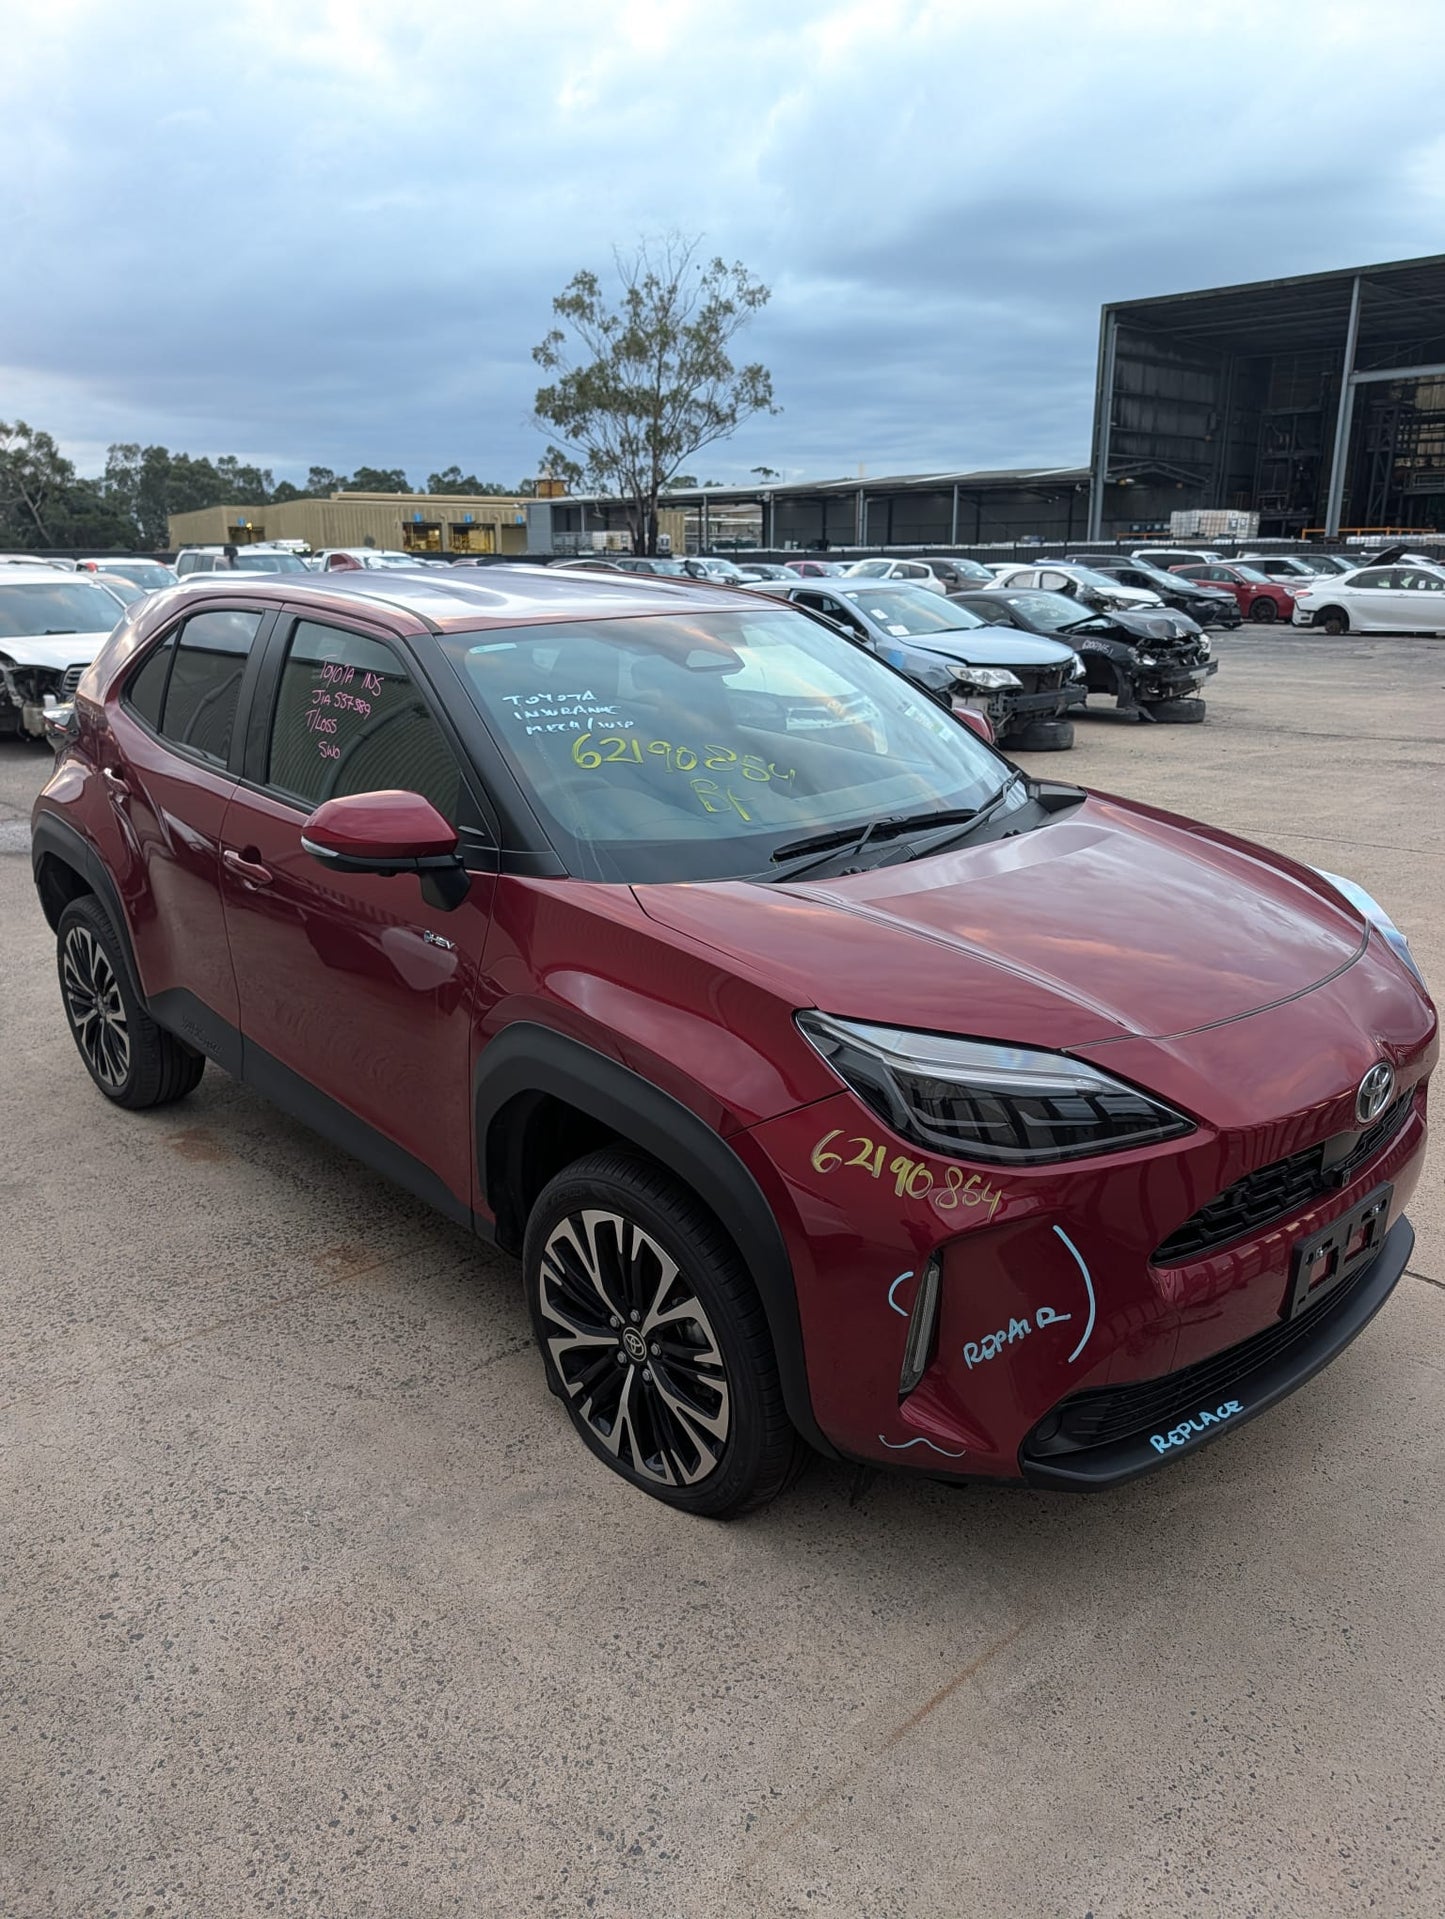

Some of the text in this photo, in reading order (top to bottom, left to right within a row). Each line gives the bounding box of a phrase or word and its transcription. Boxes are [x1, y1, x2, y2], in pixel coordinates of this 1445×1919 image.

[361, 672, 385, 697] INS
[502, 689, 597, 706] TOYOTA
[305, 708, 338, 734] T/LOSS
[572, 733, 797, 785] 62190854
[810, 1129, 1002, 1224] 62190854
[963, 1306, 1072, 1370] REPAIR
[1149, 1399, 1245, 1454] REPLACE
